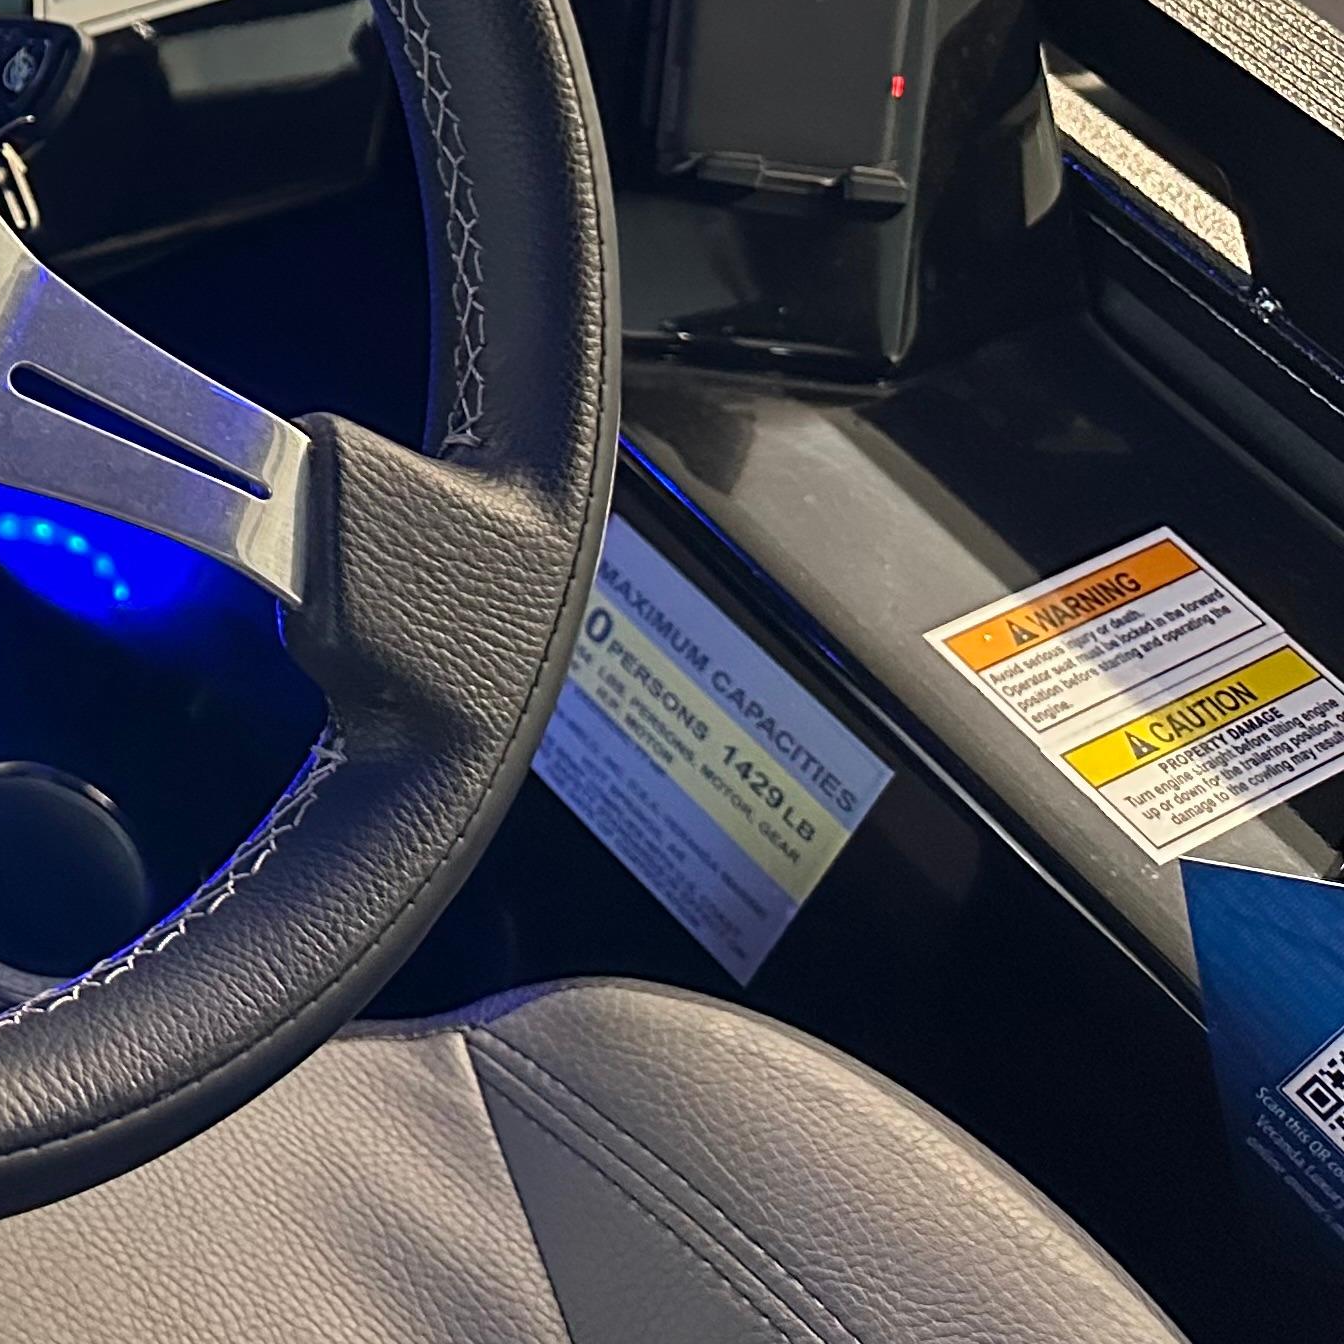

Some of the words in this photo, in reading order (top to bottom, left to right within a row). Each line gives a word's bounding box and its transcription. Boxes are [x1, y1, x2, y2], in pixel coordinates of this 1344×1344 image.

[1034, 572, 1142, 630] WARNING
[989, 663, 1025, 684] Avoid
[1022, 645, 1065, 669] serious
[1066, 630, 1098, 649] injury
[1096, 623, 1110, 635] or
[1001, 669, 1052, 698] Operator
[1050, 658, 1078, 675] seat
[1076, 645, 1105, 661] must
[1100, 639, 1121, 651] be
[1115, 620, 1156, 644] locked
[1152, 617, 1167, 627] in
[1162, 608, 1185, 622] the
[1181, 588, 1225, 613] forward
[1016, 684, 1064, 712] position
[1060, 667, 1100, 689] before
[1098, 647, 1145, 672] starting
[1139, 636, 1163, 652] and
[1161, 613, 1216, 643] operating
[1209, 605, 1232, 618] the
[599, 559, 709, 672] MAXIMUM
[711, 671, 857, 813] CAPACITIES
[1031, 700, 1074, 724] engine.
[1149, 681, 1258, 742] CAUTION
[607, 640, 709, 741] PERSONS
[723, 745, 785, 810] 1429
[782, 806, 816, 843] LB
[1123, 790, 1156, 808] Turn
[1153, 771, 1194, 795] engine
[1192, 748, 1239, 776] straight
[1230, 732, 1272, 755] before
[1267, 716, 1306, 738] tilting
[1300, 698, 1340, 722] engine
[1141, 807, 1161, 820] up
[1159, 799, 1175, 811] or
[1173, 784, 1207, 804] down
[1201, 774, 1221, 789] for
[1219, 765, 1244, 780] the
[1239, 741, 1294, 771] trailering
[1288, 719, 1340, 747] position,
[1158, 733, 1229, 773] PROPERTY
[1226, 706, 1284, 740] DAMAGE
[1171, 798, 1217, 826] damage
[1213, 791, 1230, 802] to
[1226, 781, 1250, 796] the
[1247, 760, 1295, 787] cowling
[1289, 748, 1317, 765] may
[1256, 1086, 1286, 1121] Scan
[1285, 1116, 1311, 1144] this
[1309, 1140, 1332, 1162] QR
